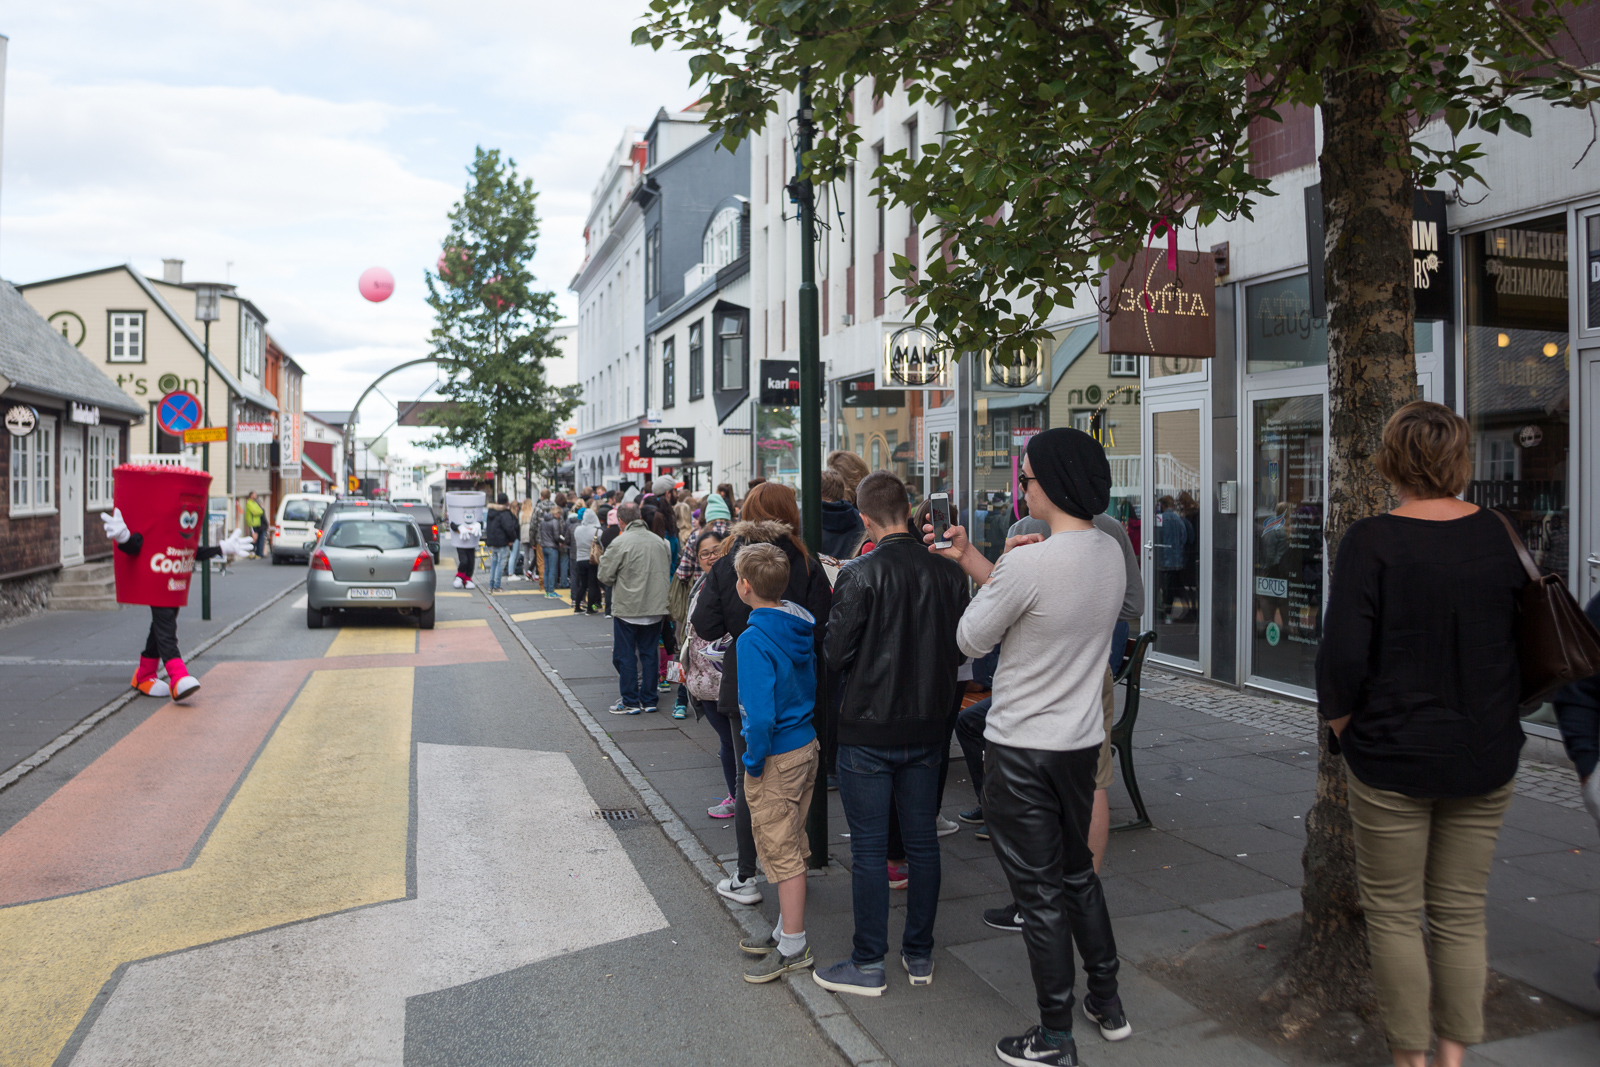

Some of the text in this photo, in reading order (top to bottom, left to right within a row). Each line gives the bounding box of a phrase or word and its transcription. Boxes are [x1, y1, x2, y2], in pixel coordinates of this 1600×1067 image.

[1412, 220, 1438, 251] IM
[1414, 258, 1431, 289] RS
[116, 373, 199, 396] t's On
[768, 377, 800, 390] karlm
[1258, 577, 1286, 595] FORTIS
